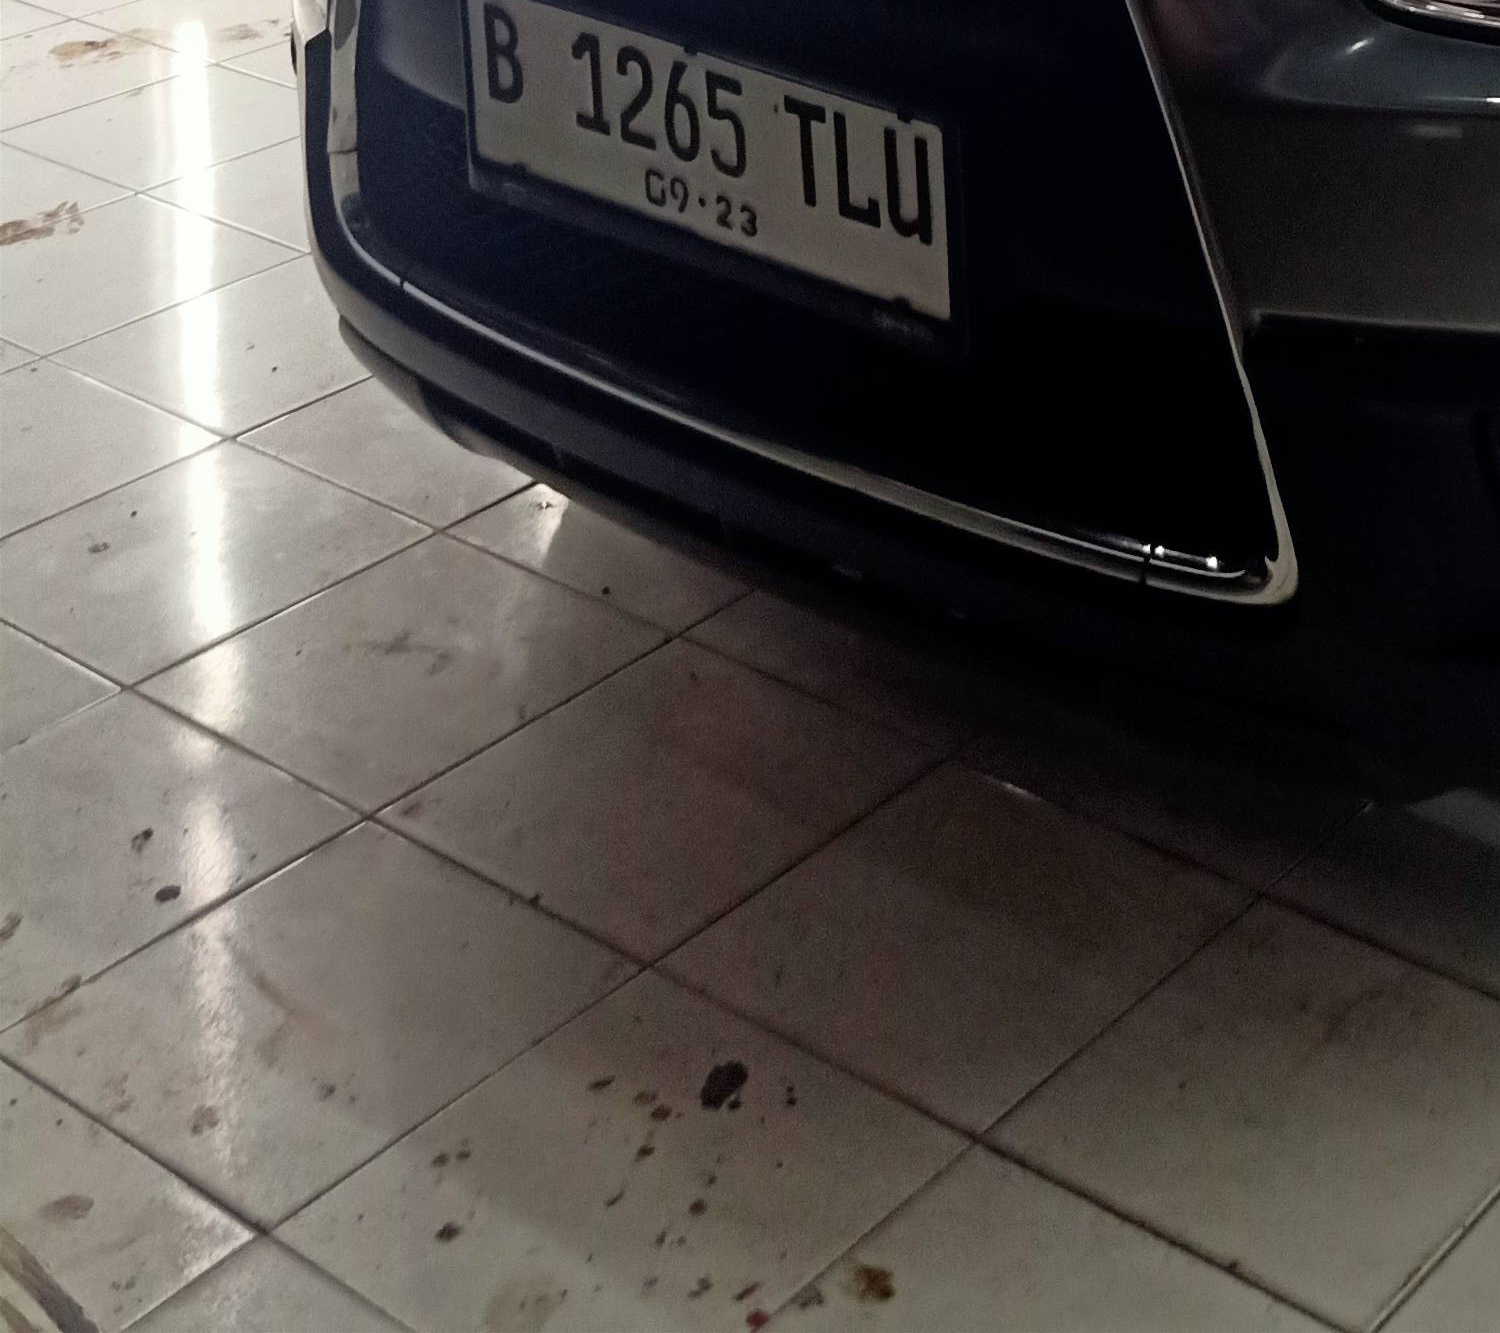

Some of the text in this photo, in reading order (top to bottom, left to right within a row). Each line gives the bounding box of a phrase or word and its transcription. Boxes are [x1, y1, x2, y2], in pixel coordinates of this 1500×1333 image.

[484, 2, 933, 245] B 1265 TLU
